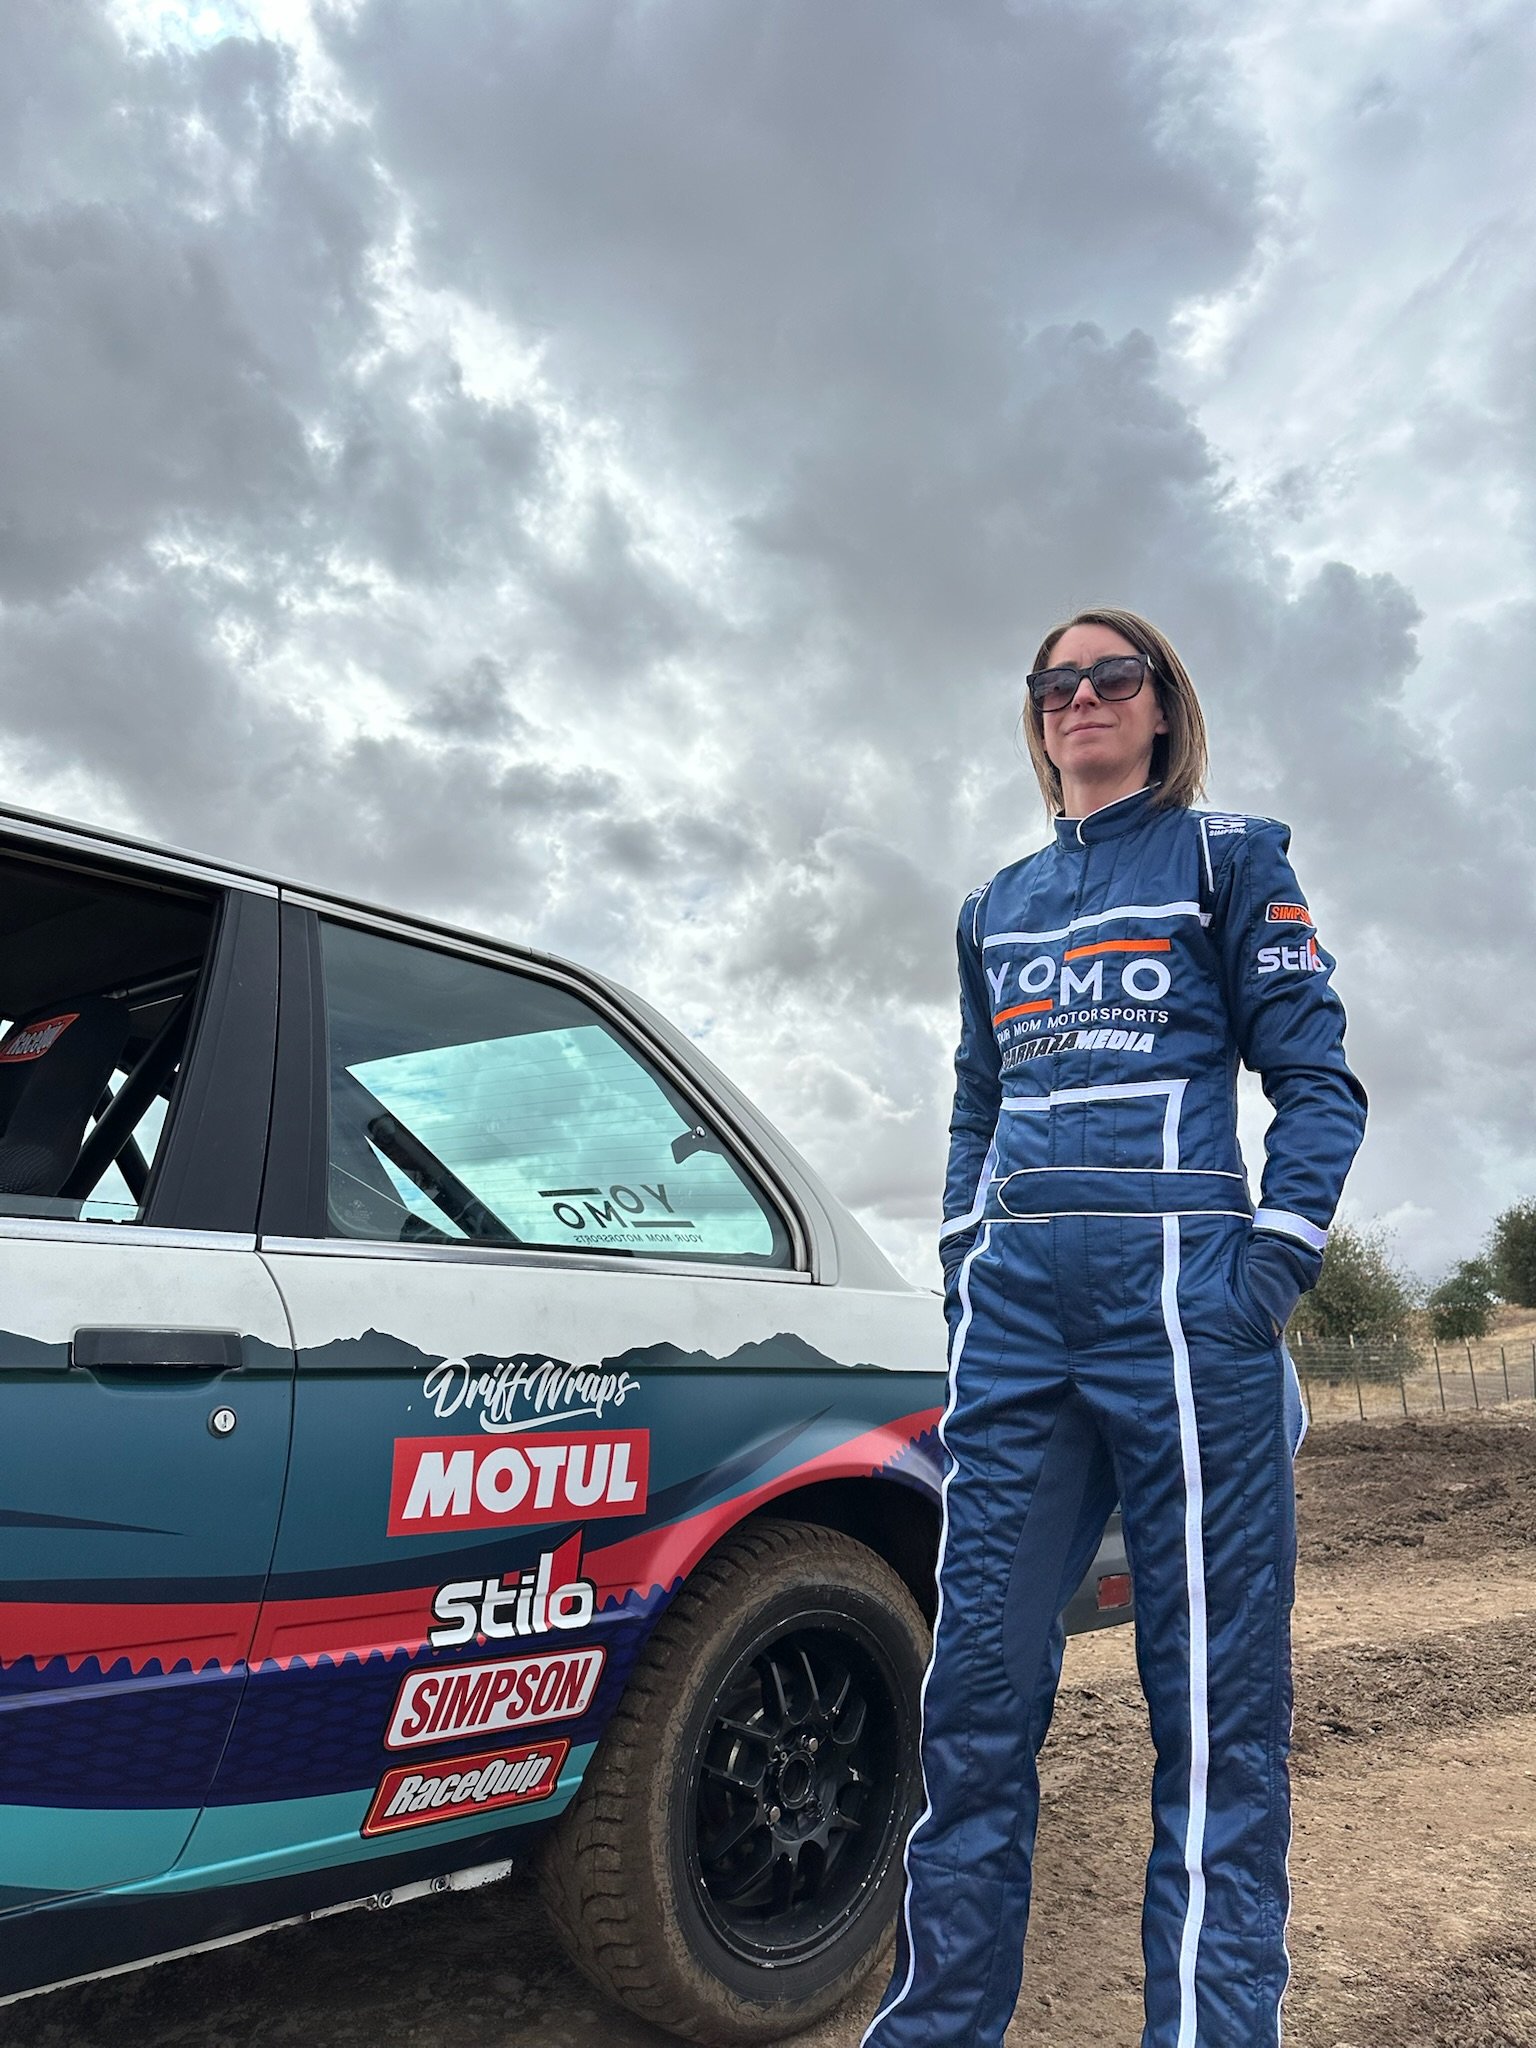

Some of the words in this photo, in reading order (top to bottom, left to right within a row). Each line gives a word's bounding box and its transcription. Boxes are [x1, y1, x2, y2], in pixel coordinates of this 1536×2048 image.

[985, 956, 1172, 1006] YOMO
[1013, 1019, 1042, 1037] MOM
[1047, 1007, 1169, 1028] MOTORSPORTS
[401, 1442, 638, 1521] MOTUL
[400, 1656, 592, 1739] SIMPSON
[383, 1752, 552, 1819] RaceQuip
